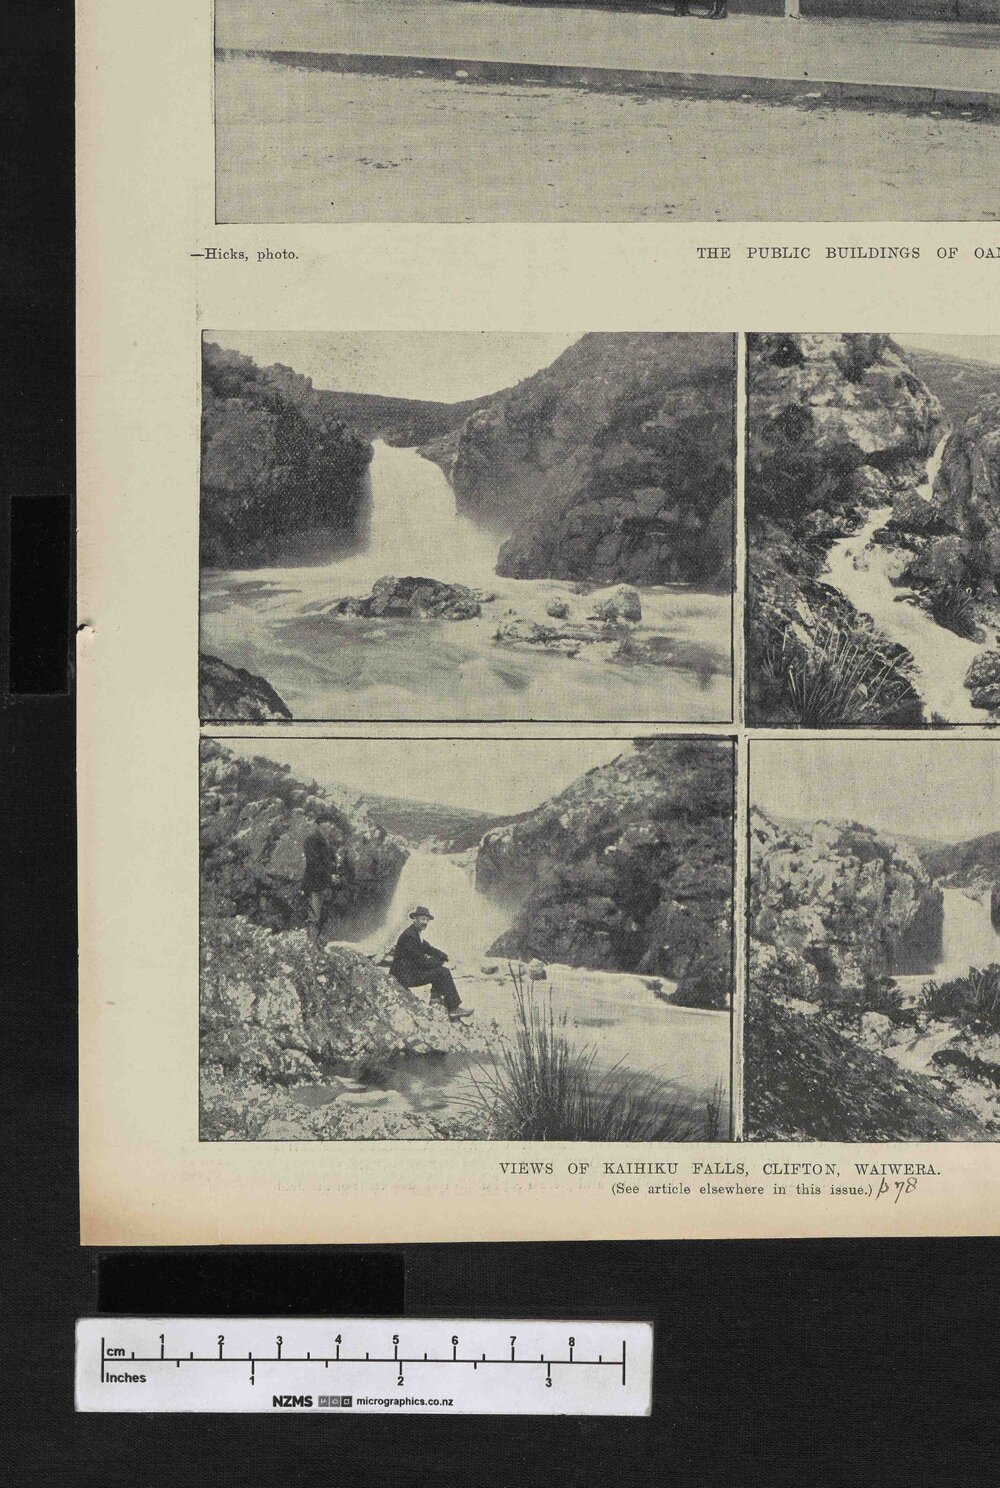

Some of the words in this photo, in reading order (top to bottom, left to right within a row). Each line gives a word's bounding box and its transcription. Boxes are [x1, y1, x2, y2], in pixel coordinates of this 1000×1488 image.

[256, 247, 299, 262] photo.
[696, 246, 732, 260] THE
[746, 246, 811, 260] PUBLIC
[825, 246, 921, 260] BUILDINGS
[936, 246, 959, 260] OF
[499, 1162, 554, 1175] VIEWS
[567, 1162, 590, 1175] OF
[602, 1162, 679, 1175] KAIHIKU
[691, 1162, 749, 1178] FALLS,
[762, 1162, 841, 1178] CLIFTON,
[853, 1163, 941, 1176] WAIWERA.
[611, 1182, 640, 1196] (See
[647, 1182, 691, 1195] article
[699, 1182, 765, 1195] elsewhere
[772, 1183, 787, 1195] in
[795, 1183, 822, 1196] this
[829, 1183, 873, 1198] issue.)
[158, 1334, 165, 1344] 1
[217, 1335, 225, 1345] 2
[276, 1335, 284, 1345] 3
[335, 1334, 343, 1345] 4
[392, 1335, 400, 1345] 5
[451, 1335, 459, 1345] 6
[509, 1336, 517, 1346] 7
[568, 1337, 576, 1347] 8
[106, 1346, 126, 1357] cm
[105, 1372, 147, 1383] Inches
[249, 1375, 255, 1385] 1
[396, 1376, 405, 1386] 2
[545, 1377, 553, 1387] 3
[272, 1395, 313, 1408] NZMS
[356, 1396, 454, 1408] micrographics.co.nz
